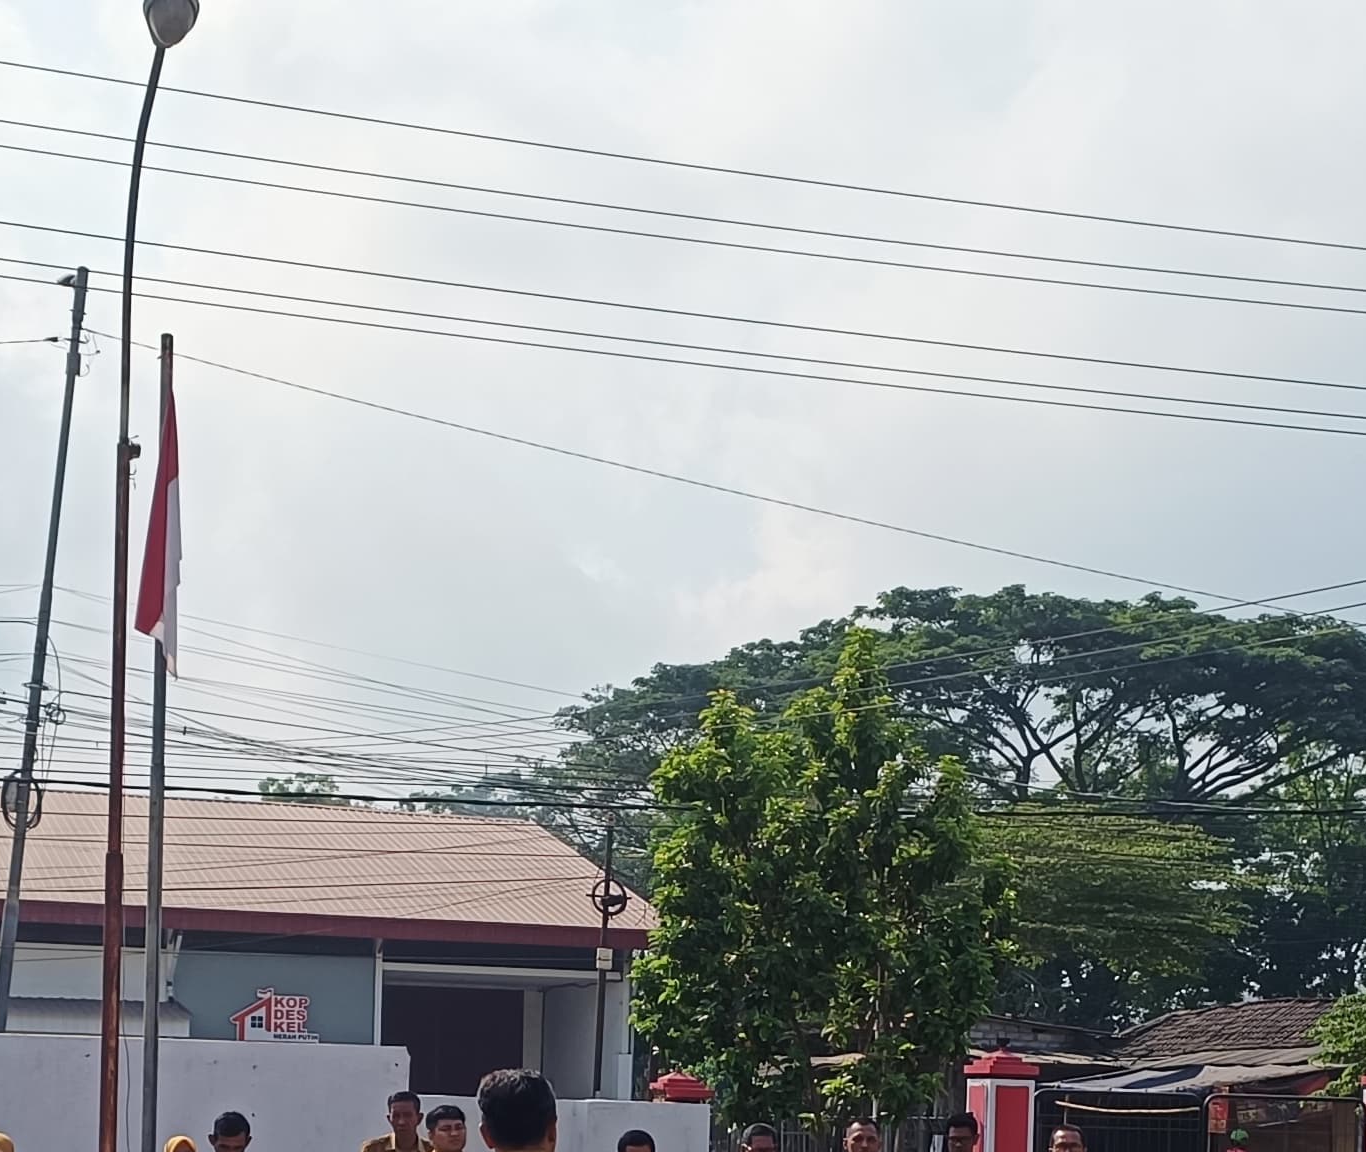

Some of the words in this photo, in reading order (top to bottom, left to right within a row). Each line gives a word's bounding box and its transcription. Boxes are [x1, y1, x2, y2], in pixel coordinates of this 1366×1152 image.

[274, 997, 308, 1009] KOP
[274, 1009, 306, 1021] DES
[274, 1021, 307, 1033] KEL
